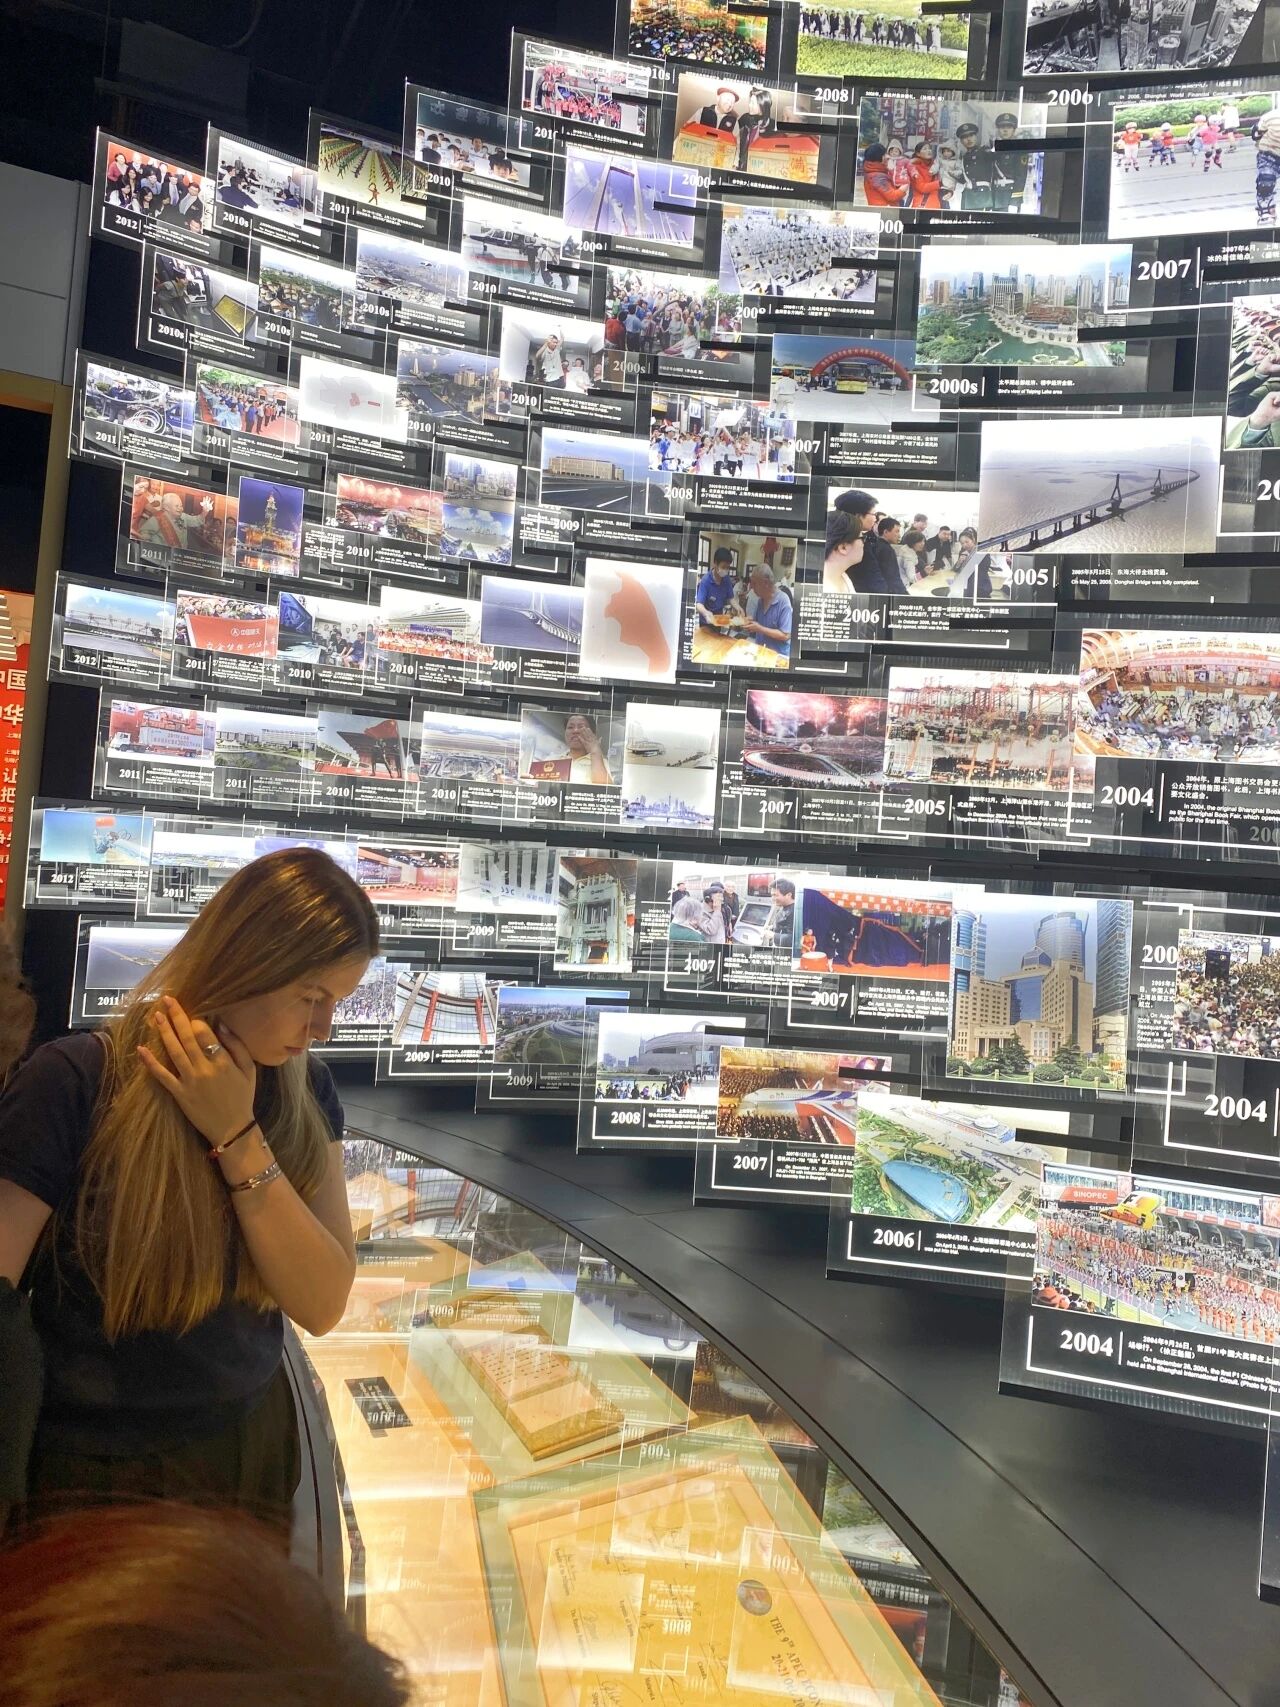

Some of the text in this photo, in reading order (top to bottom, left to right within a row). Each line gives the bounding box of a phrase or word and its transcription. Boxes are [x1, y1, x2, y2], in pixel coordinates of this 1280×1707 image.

[814, 87, 848, 103] 2008
[1047, 88, 1094, 106] 2006
[329, 202, 350, 214] 2011
[115, 214, 138, 230] 2012
[222, 212, 249, 228] 2010s
[1137, 258, 1192, 281] 2007
[472, 281, 497, 294] 2010
[362, 303, 390, 317] 2010s
[158, 324, 184, 340] 2010s
[264, 321, 291, 336] 2010s
[612, 360, 646, 374] 2000s
[929, 378, 978, 394] 2000s
[512, 394, 537, 406] 2010
[408, 420, 432, 432] 2010
[95, 432, 116, 444] 2011
[206, 434, 227, 447] 2011
[310, 431, 332, 444] 2011
[789, 439, 821, 454] 007
[664, 486, 694, 500] 2008
[554, 520, 580, 532] 2009
[141, 549, 162, 560] 2011
[346, 544, 370, 558] 2010
[843, 608, 880, 624] 2006
[74, 654, 97, 666] 2012
[186, 659, 207, 670] 2011
[492, 660, 518, 672] 2009
[288, 668, 312, 680] 2010
[390, 662, 414, 675] 2010
[0, 704, 24, 726] 华
[120, 768, 141, 780] 2011
[226, 778, 247, 789] 2011
[1186, 775, 1280, 787] 2004年，原上海图书交易会更
[326, 786, 350, 798] 2010
[431, 788, 456, 800] 2010
[1100, 786, 1154, 807] 2004
[532, 795, 558, 806] 2009
[759, 800, 794, 814] 2007
[904, 798, 946, 816] 2005
[1188, 810, 1214, 818] Shanghai
[1216, 806, 1237, 814] original
[1238, 806, 1265, 814] Shanghai
[50, 874, 74, 884] 2012
[162, 888, 184, 898] 2011
[469, 925, 496, 936] 2009
[1142, 944, 1178, 964] 200
[684, 958, 716, 972] 2007
[97, 996, 119, 1006] 2011
[811, 990, 848, 1007] 2007
[404, 1051, 430, 1062] 2009
[506, 1074, 534, 1086] 2009
[1204, 1094, 1268, 1123] 2004
[610, 1111, 641, 1124] 2008
[733, 1155, 768, 1170] 2007
[1073, 1190, 1108, 1200] SINOPEC
[873, 1228, 915, 1248] 2006
[1060, 1330, 1114, 1357] 2004
[1146, 1363, 1156, 1371] the
[1156, 1364, 1183, 1376] Shanghai
[1183, 1370, 1219, 1382] International
[1210, 1367, 1220, 1376] the
[1240, 1373, 1265, 1383] Chinese
[770, 1616, 786, 1636] THE
[786, 1652, 808, 1678] APEC
